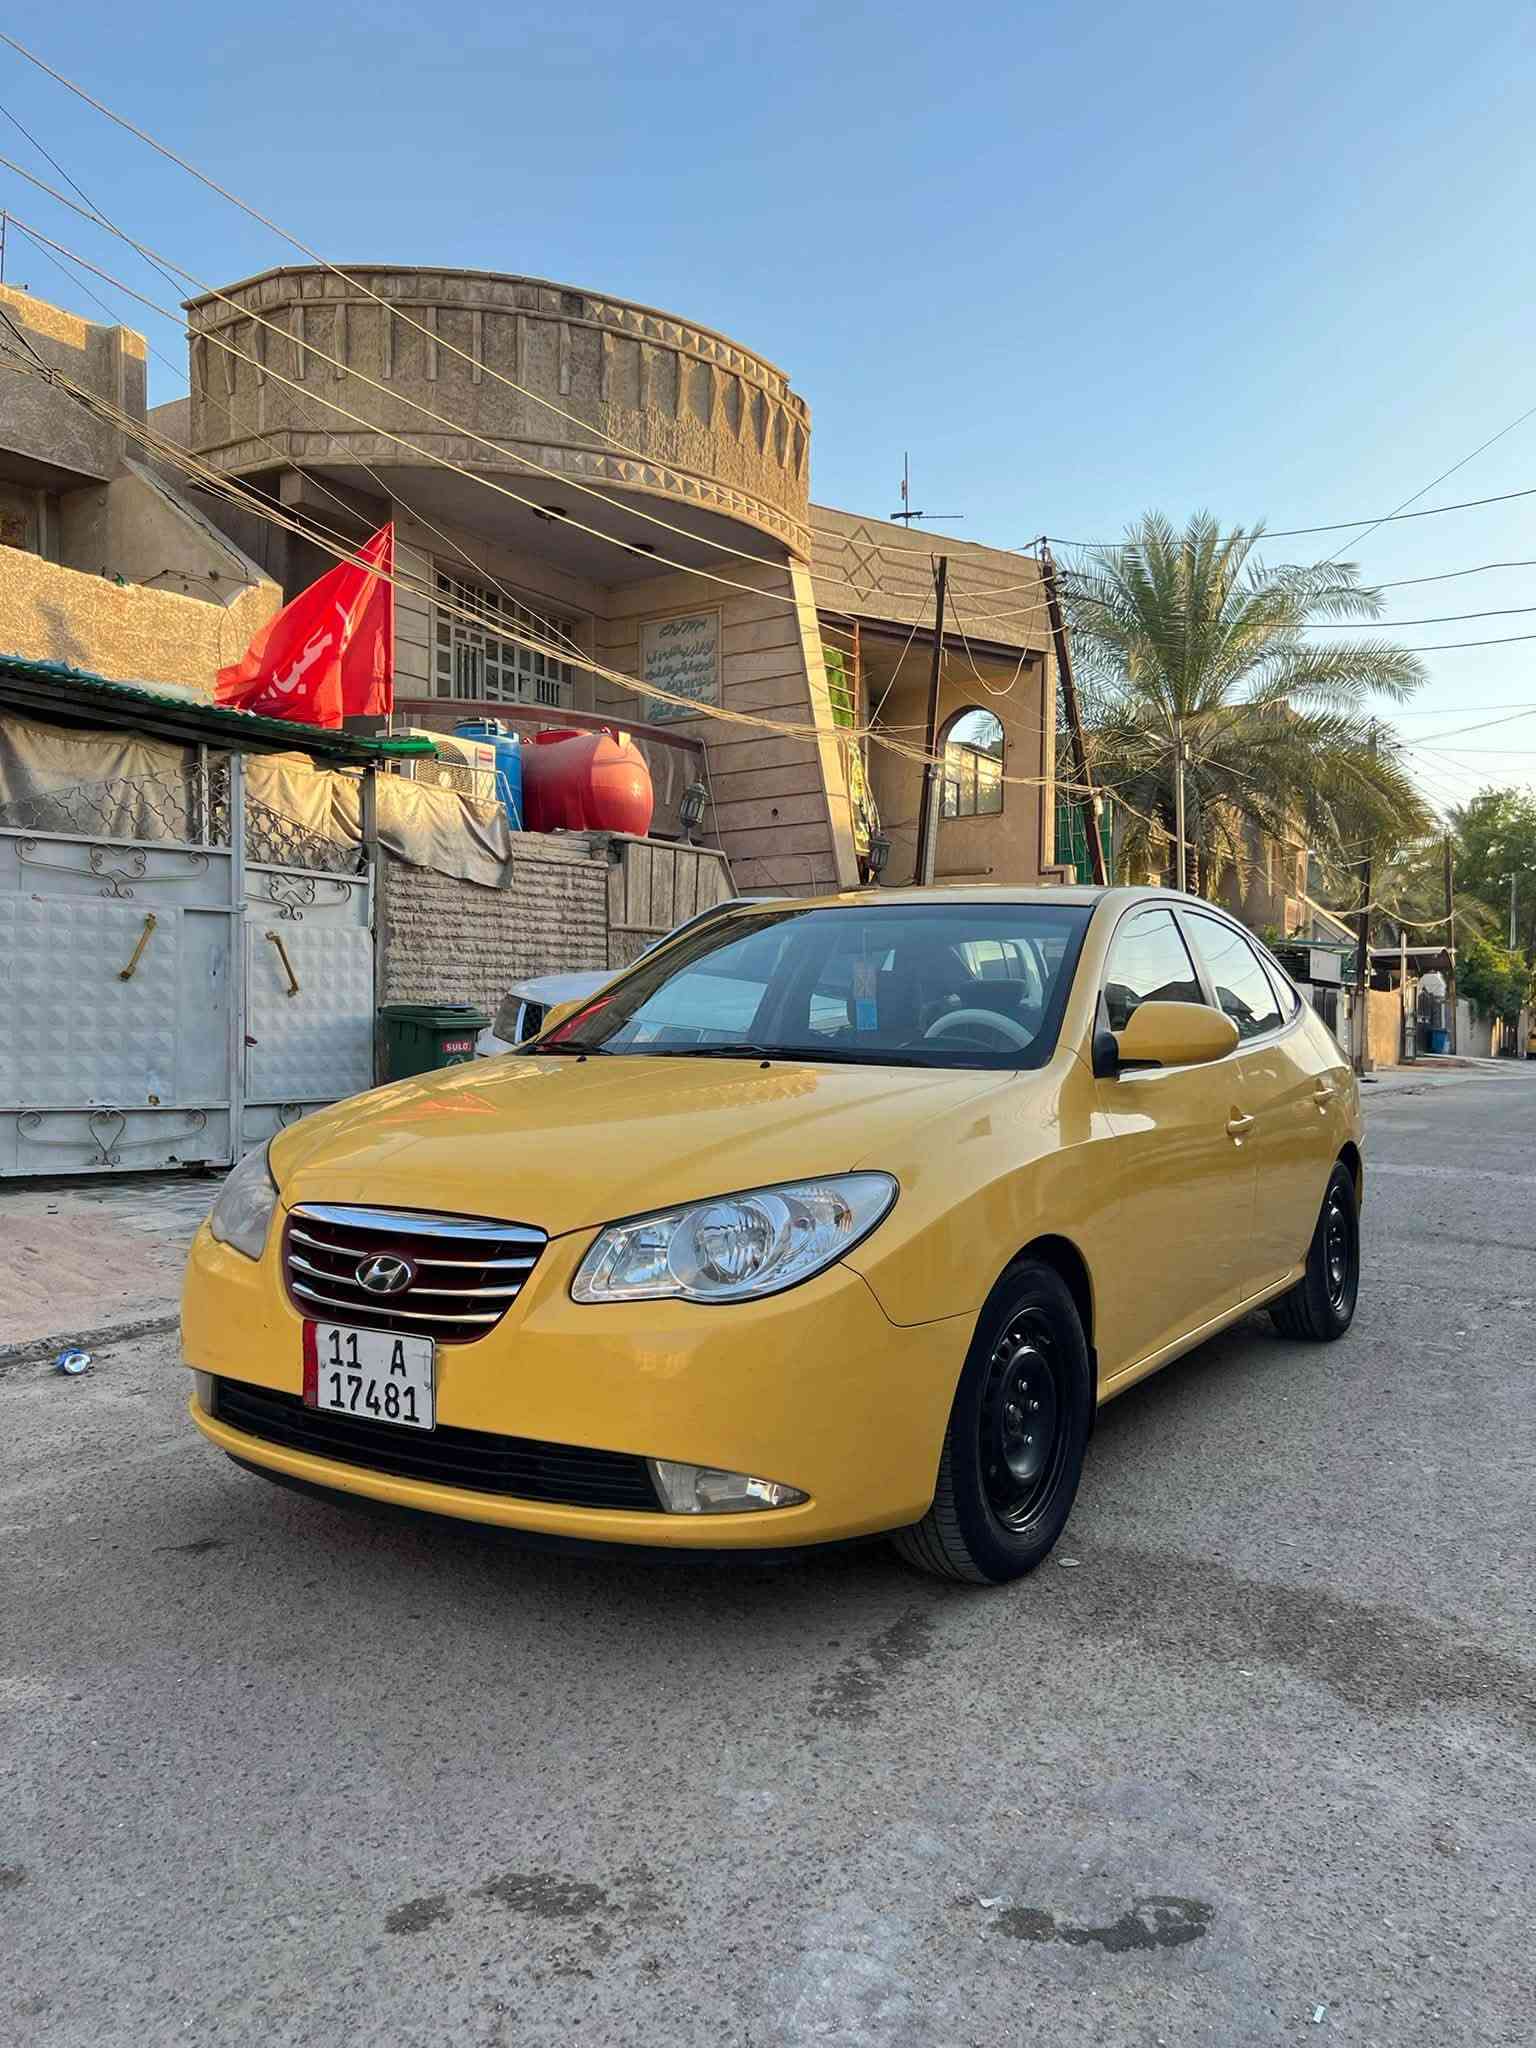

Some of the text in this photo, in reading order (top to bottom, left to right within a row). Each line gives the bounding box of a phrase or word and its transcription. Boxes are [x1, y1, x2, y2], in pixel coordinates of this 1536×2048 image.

[446, 1042, 470, 1051] SULO
[328, 1328, 407, 1378] 11 A
[329, 1371, 420, 1423] 17481
